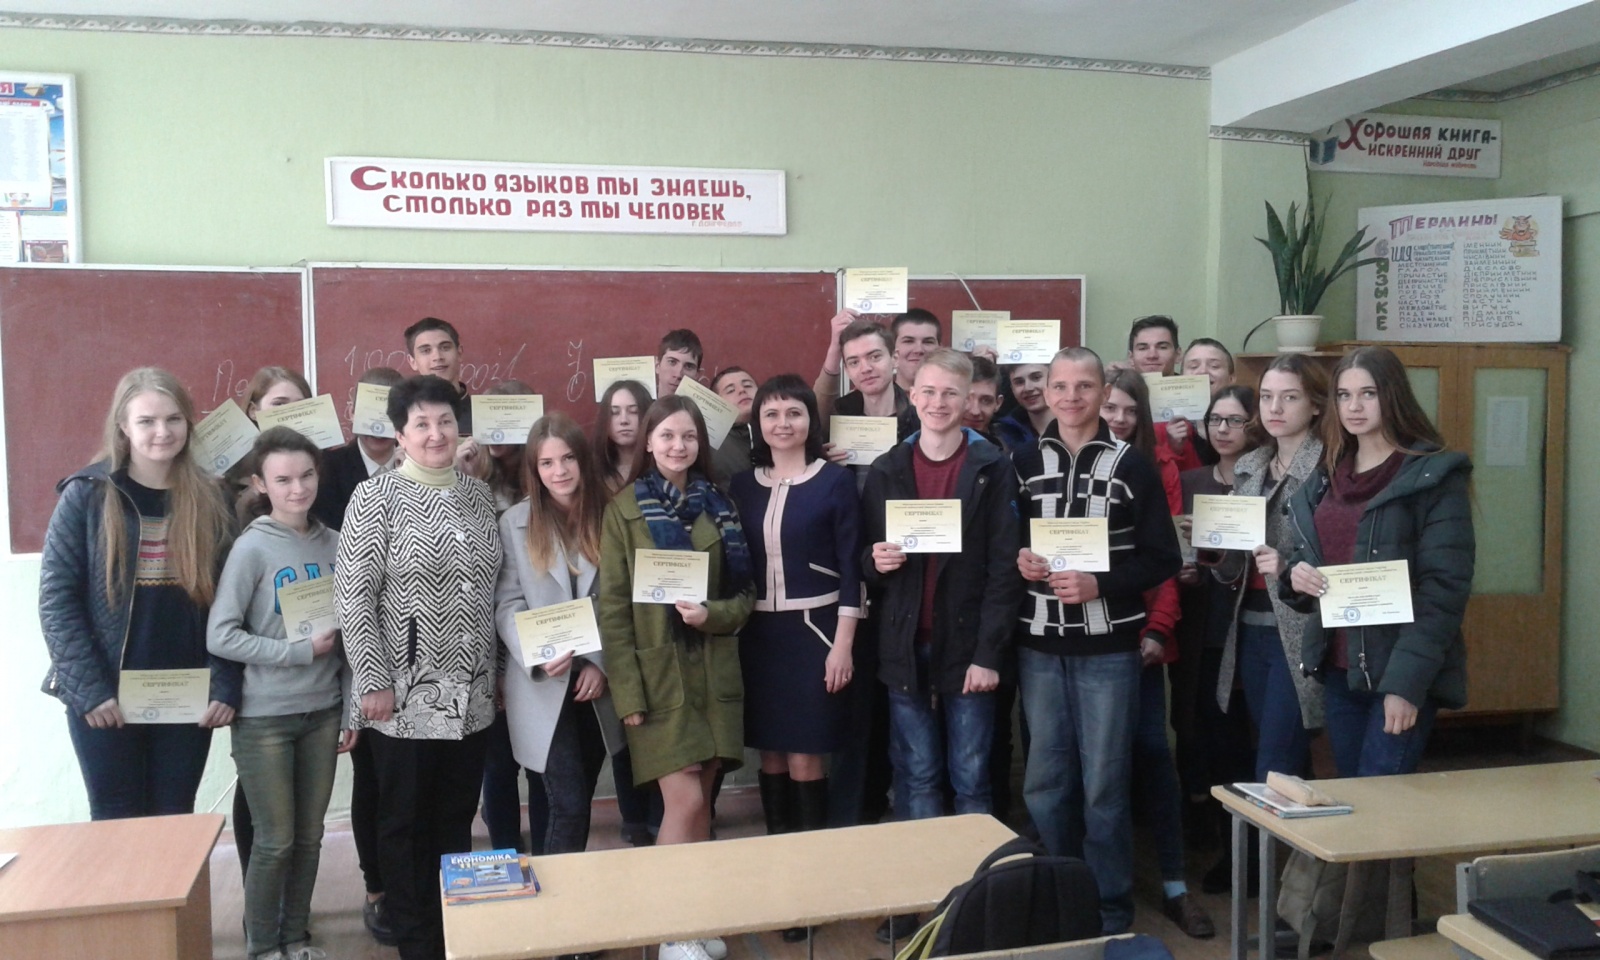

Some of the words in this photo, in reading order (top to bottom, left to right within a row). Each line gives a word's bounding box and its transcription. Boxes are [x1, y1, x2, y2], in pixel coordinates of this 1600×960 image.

[1338, 118, 1431, 150] ХОРОШАЯ
[1438, 126, 1497, 144] КНИГА-
[1367, 143, 1443, 159] ИСКРЕННИЙ
[1447, 147, 1481, 161] ДРУГ
[350, 165, 487, 192] СКОЛЬКО
[494, 173, 589, 194] ЯЗЫКОВ
[597, 176, 639, 196] ТЫ
[650, 178, 752, 201] ЗНАЕШЬ,
[382, 194, 512, 216] СТОЛЬКО
[526, 201, 573, 218] РАЗ
[581, 202, 620, 219] ТЫ
[628, 202, 726, 221] ЧЕЛОВЕК
[1388, 214, 1498, 240] ТЕРМИНЫ
[451, 853, 512, 864] ЕКОНОМІКА
